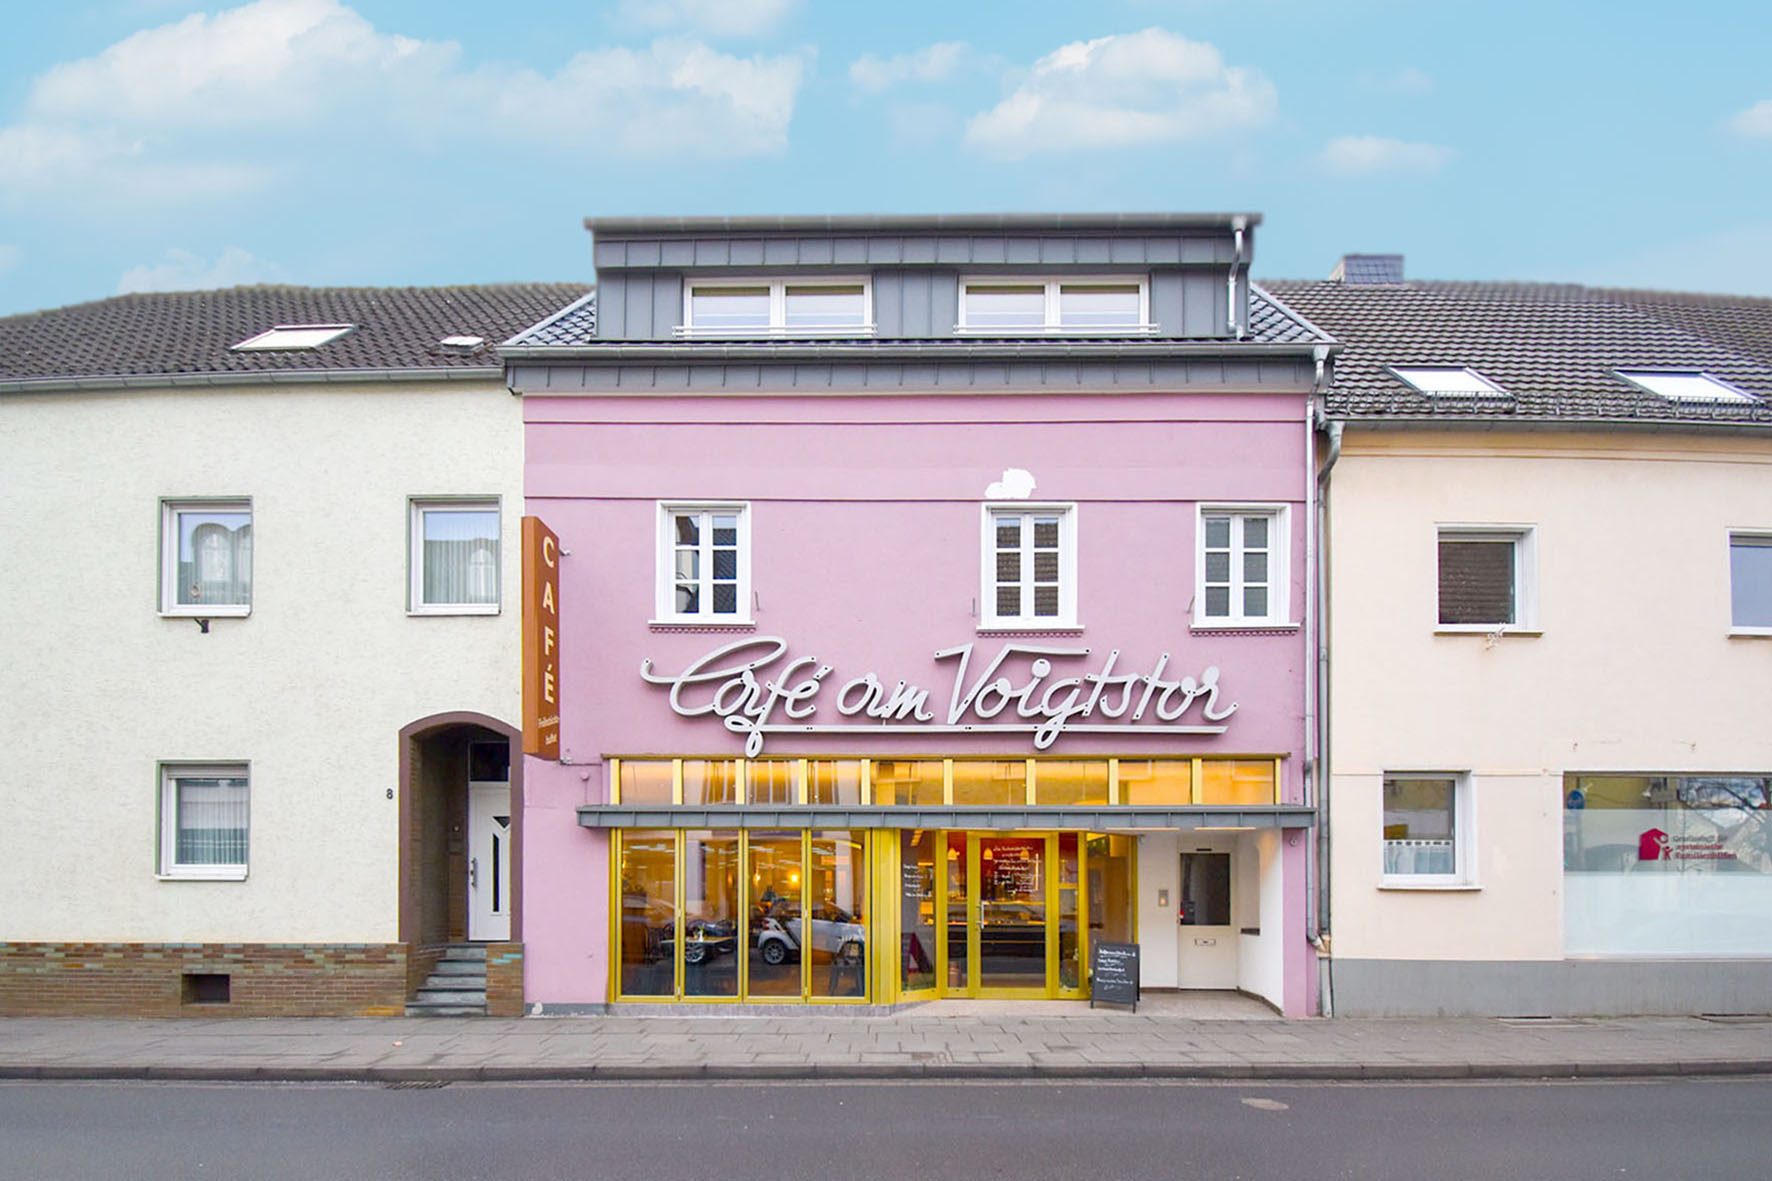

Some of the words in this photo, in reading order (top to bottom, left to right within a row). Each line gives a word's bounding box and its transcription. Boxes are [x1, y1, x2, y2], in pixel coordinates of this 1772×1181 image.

[543, 536, 555, 703] CAFÉ
[640, 635, 833, 758] Café
[836, 672, 934, 722] am
[386, 788, 393, 800] 8
